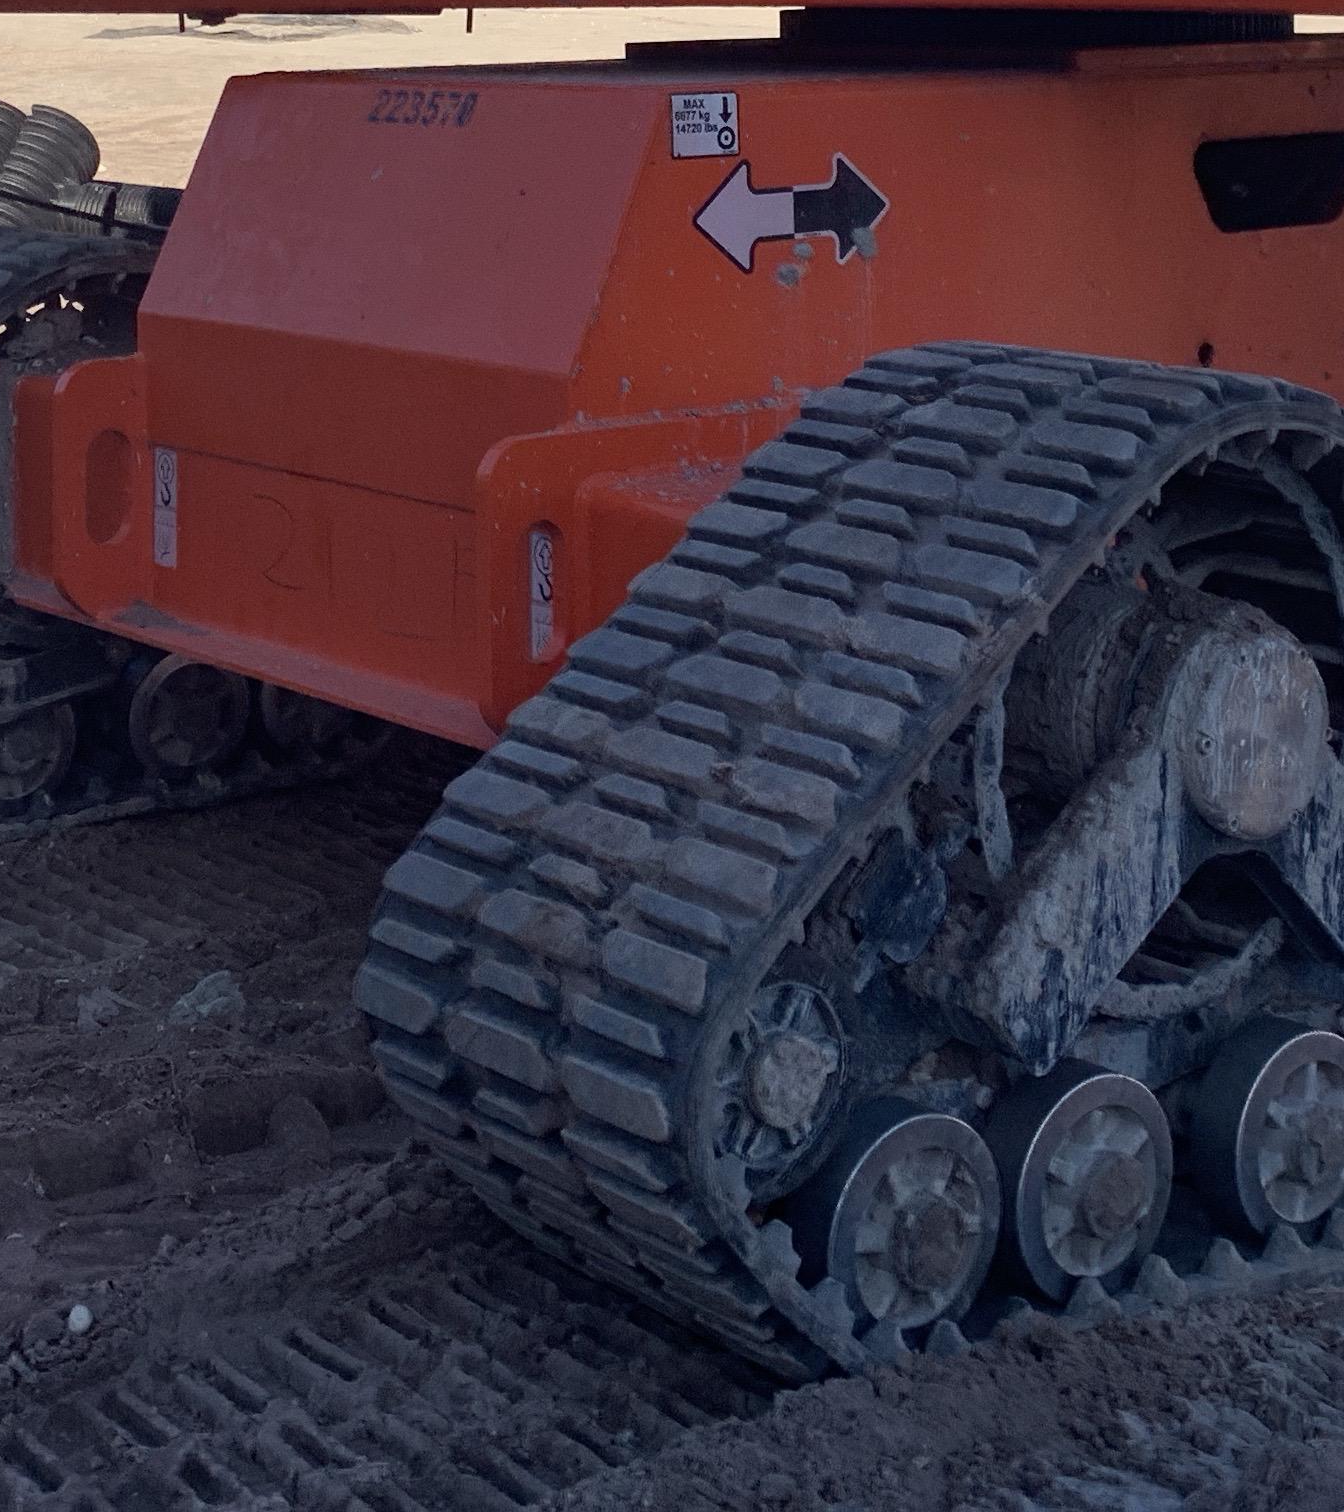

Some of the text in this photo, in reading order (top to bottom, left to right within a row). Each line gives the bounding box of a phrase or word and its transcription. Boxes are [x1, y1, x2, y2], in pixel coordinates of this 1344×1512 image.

[683, 99, 705, 109] MAX
[698, 110, 710, 123] kg
[704, 123, 719, 133] lbs
